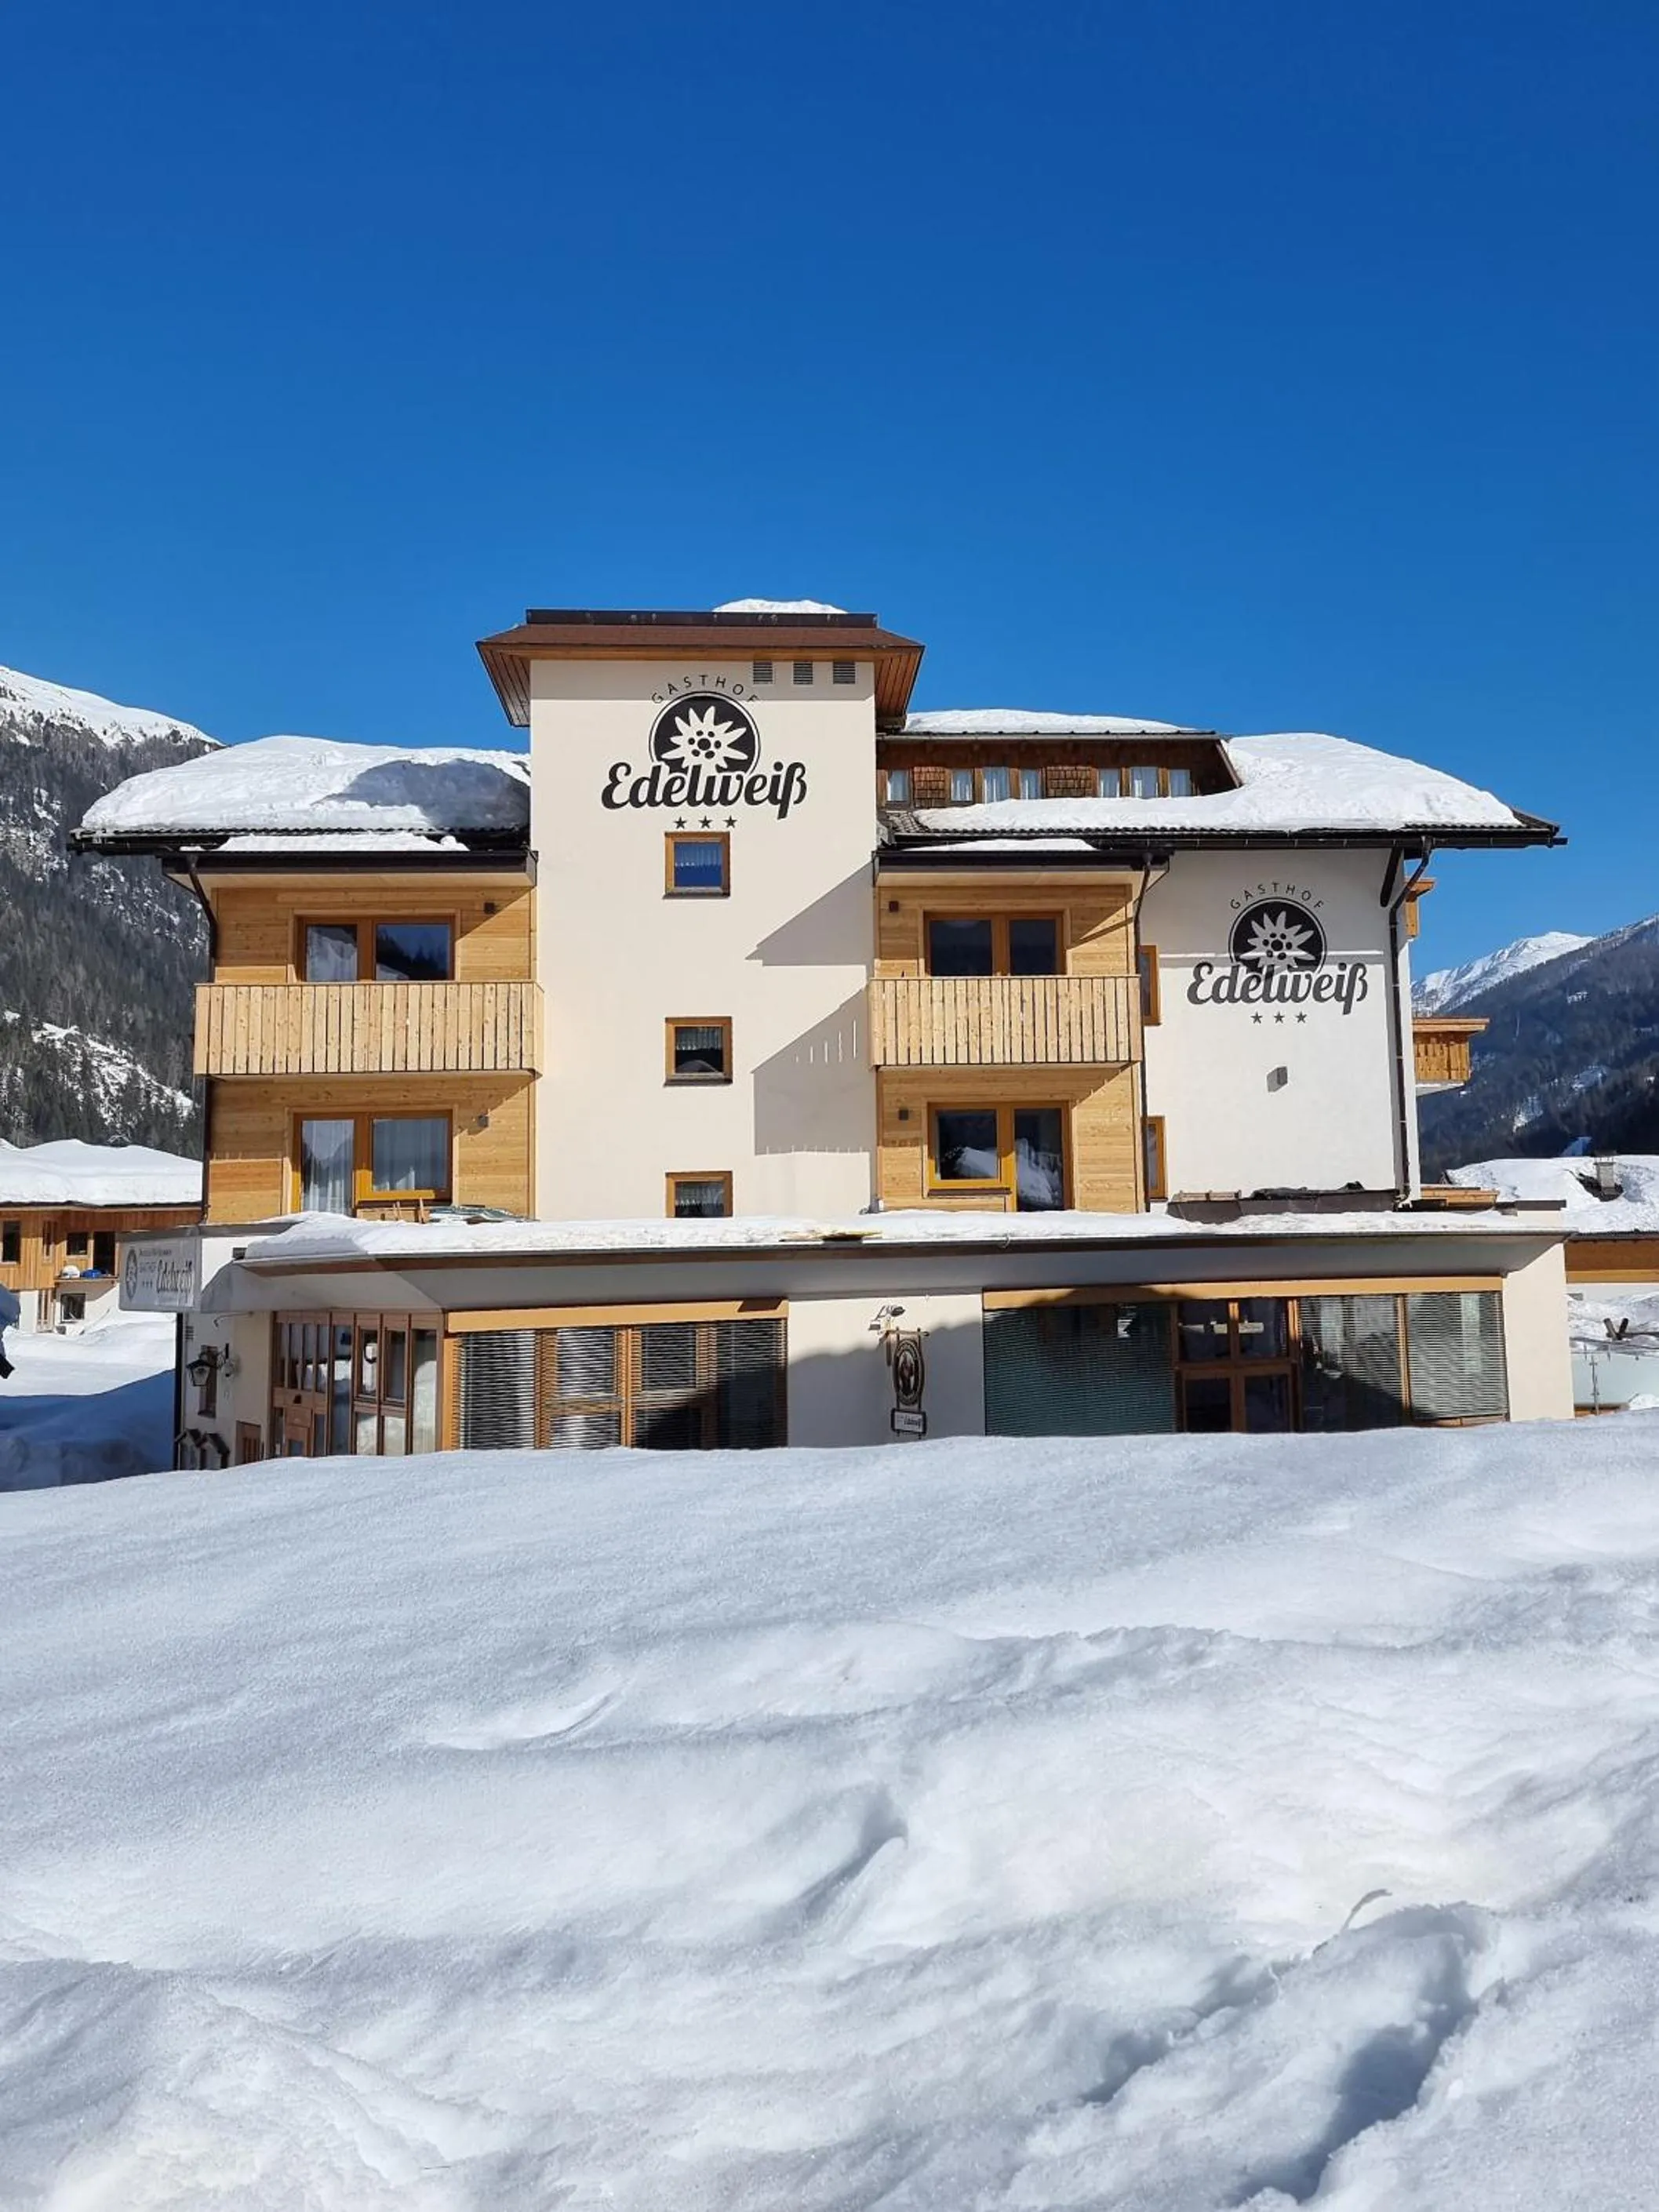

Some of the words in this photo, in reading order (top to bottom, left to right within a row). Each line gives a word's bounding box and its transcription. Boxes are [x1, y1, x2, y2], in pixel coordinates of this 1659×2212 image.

[651, 675, 759, 704] GASTHOF
[601, 762, 807, 820] Edelweiß
[1230, 882, 1325, 910] GASTHOF
[1187, 962, 1368, 1015] Edelweiß
